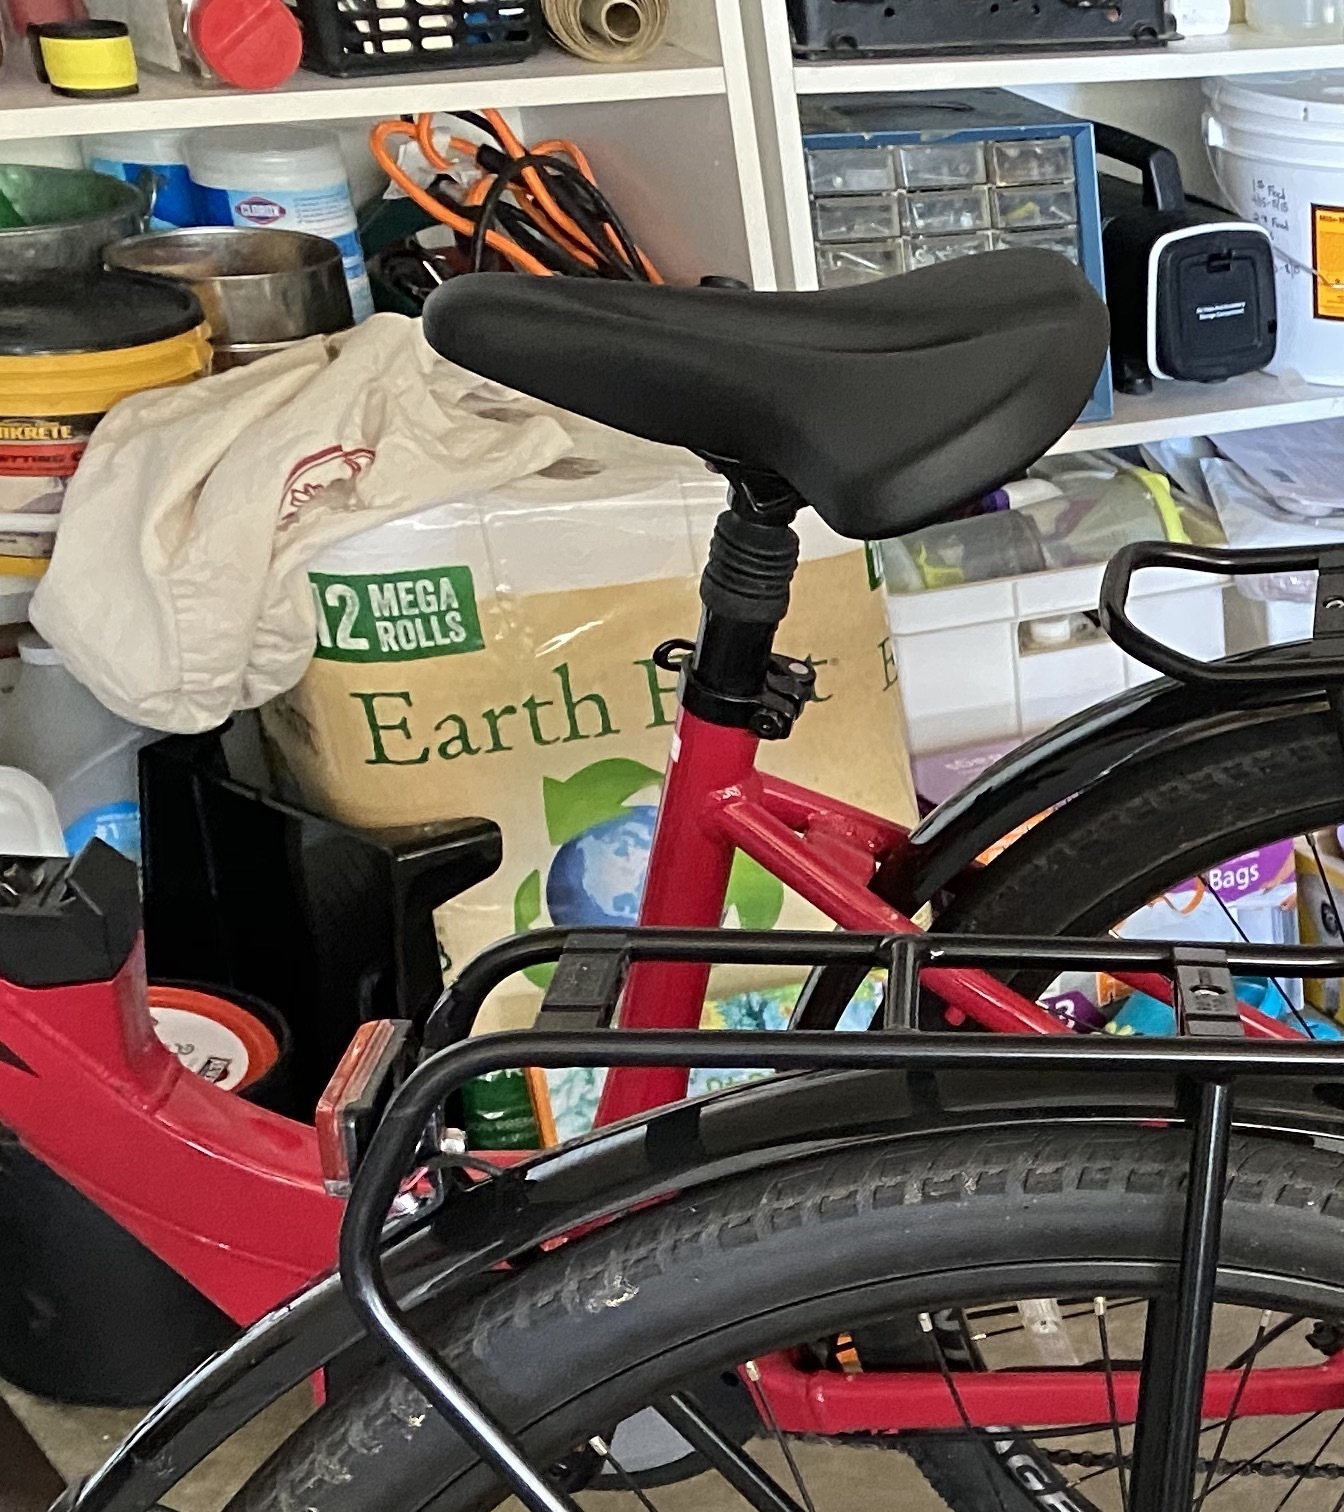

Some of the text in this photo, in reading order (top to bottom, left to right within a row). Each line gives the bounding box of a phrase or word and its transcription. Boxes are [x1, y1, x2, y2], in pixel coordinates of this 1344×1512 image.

[310, 576, 459, 650] 12 MEGA
[375, 610, 467, 652] ROLLS
[349, 662, 621, 766] Earth
[1208, 863, 1261, 891] Bags
